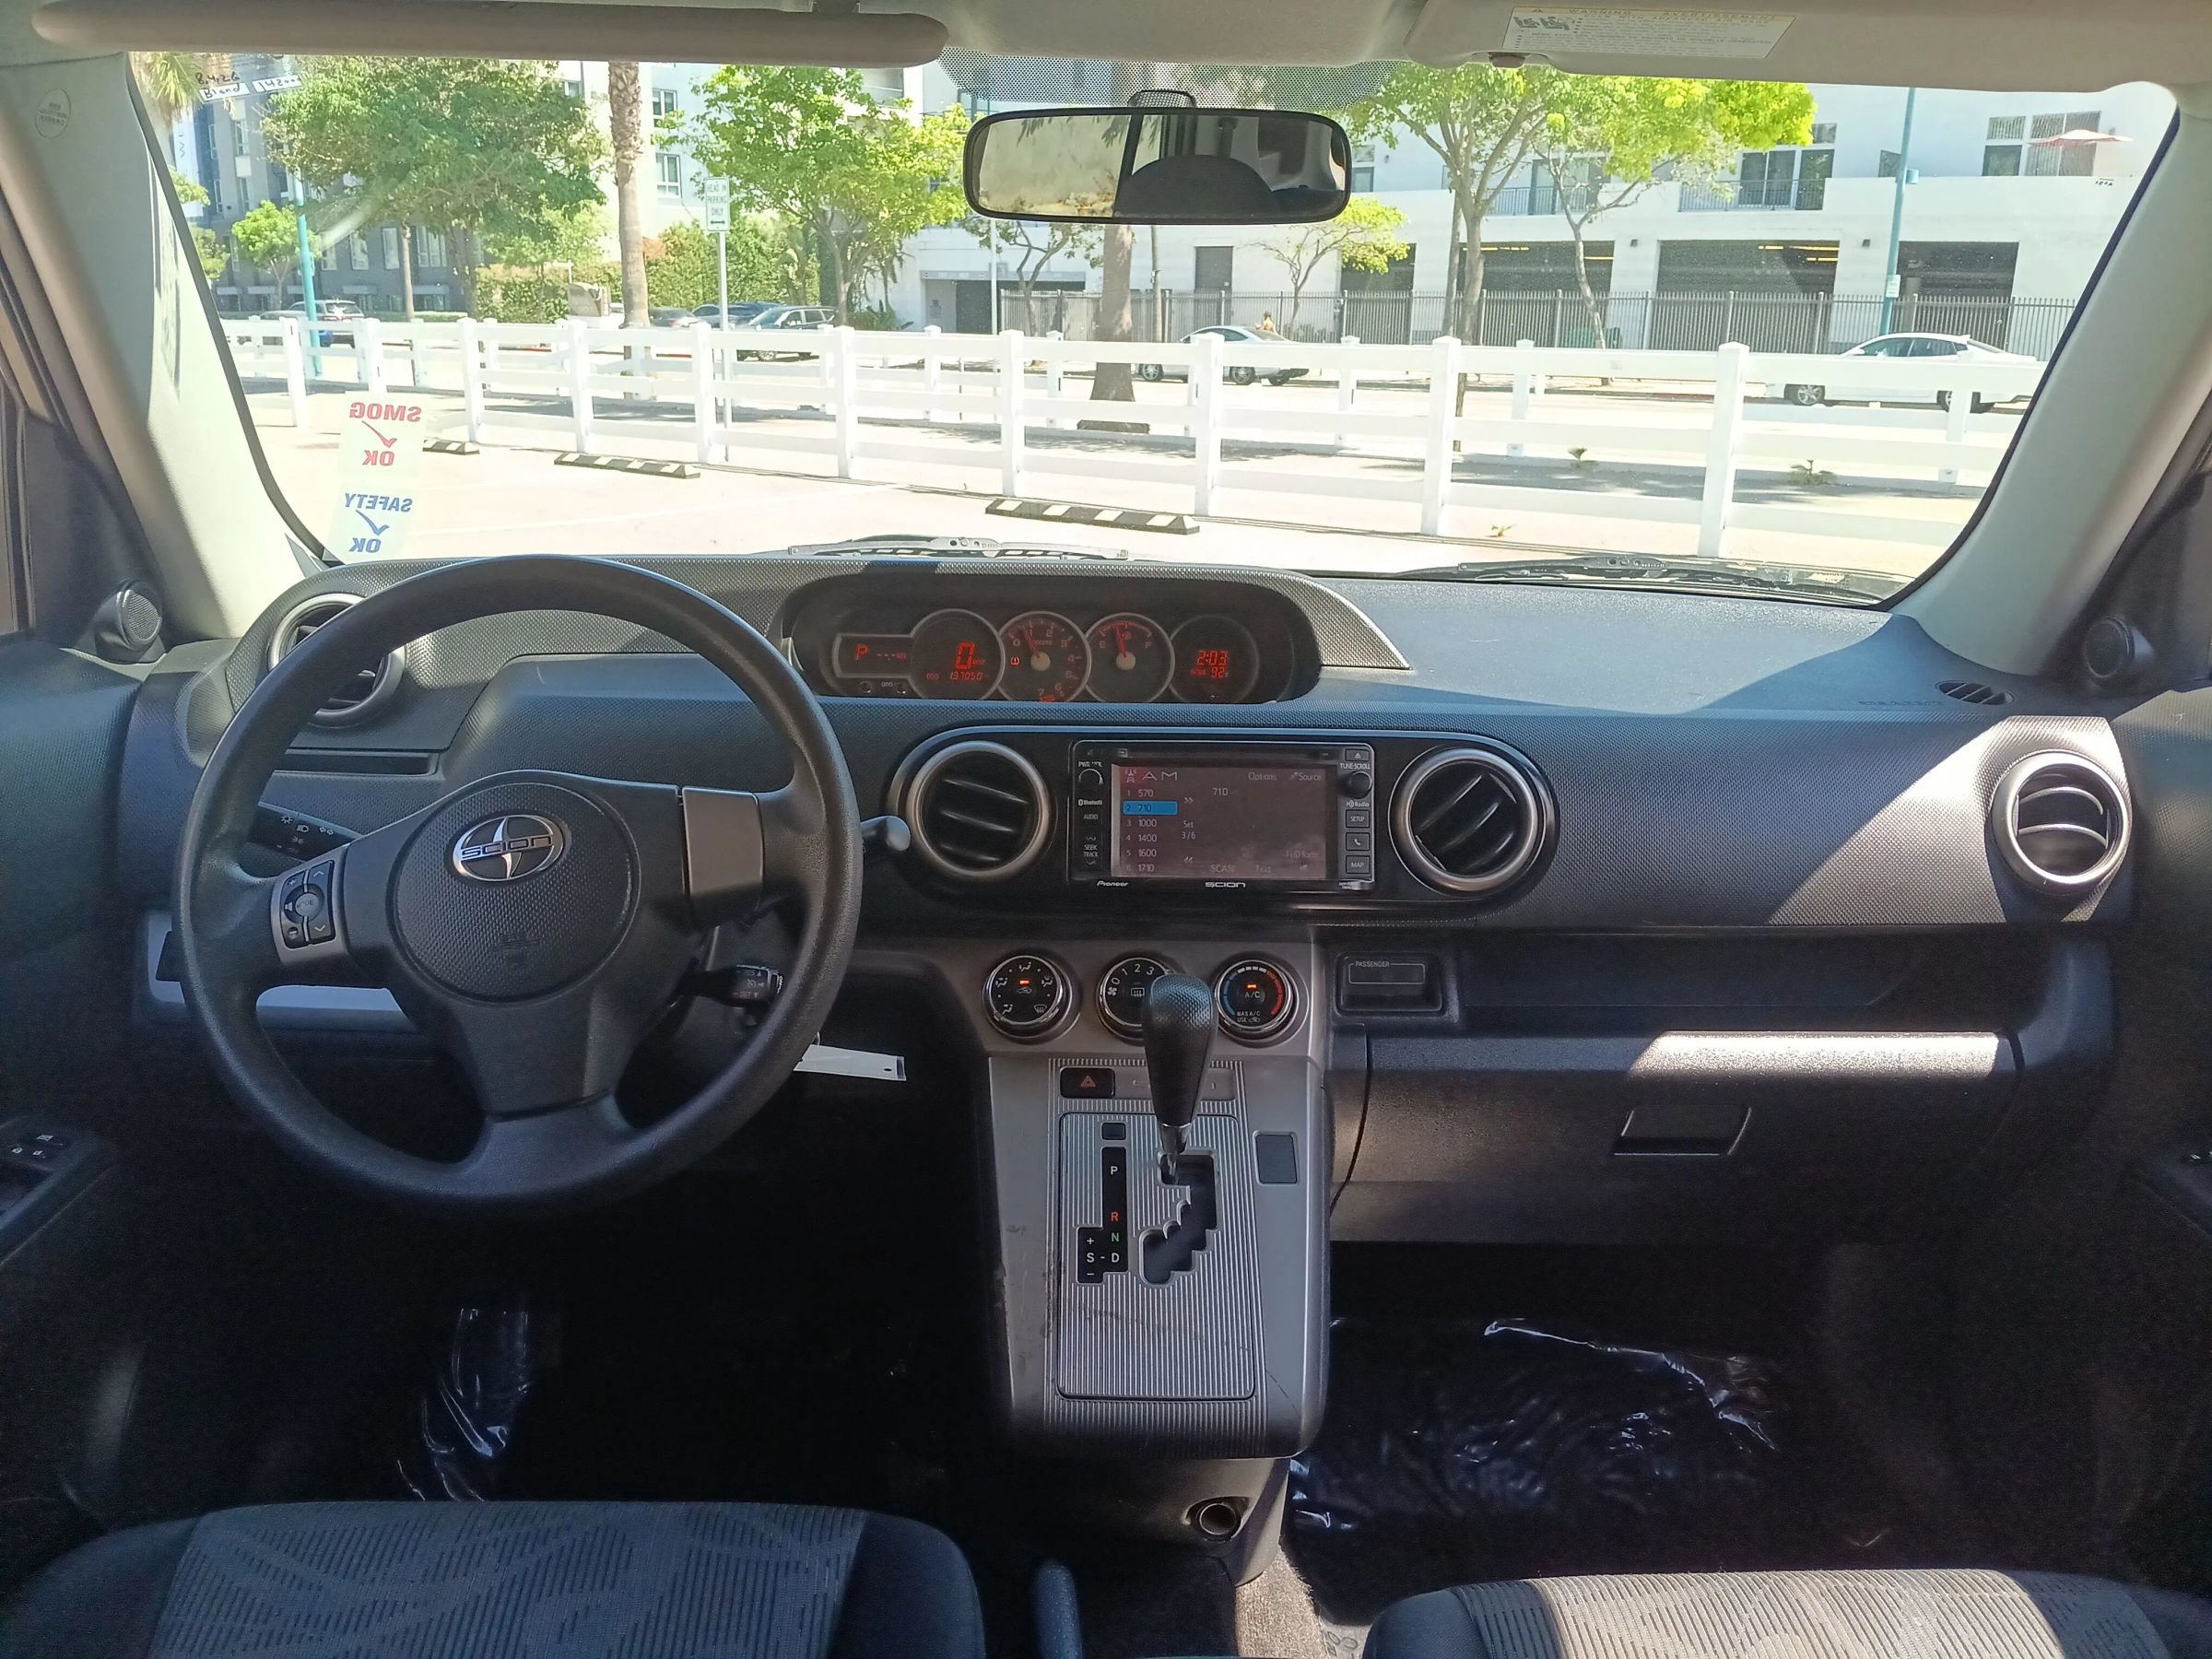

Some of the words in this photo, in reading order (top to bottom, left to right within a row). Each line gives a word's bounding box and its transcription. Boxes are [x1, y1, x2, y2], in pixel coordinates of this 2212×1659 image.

[855, 644, 869, 661] P
[955, 642, 975, 670] 0
[1196, 649, 1228, 665] 2:03
[949, 672, 983, 681] 137050
[1248, 771, 1277, 781] Options
[1298, 773, 1322, 782] Source
[1138, 789, 1154, 797] 570
[1212, 787, 1229, 796] 710
[1138, 804, 1152, 812] 710
[1138, 819, 1158, 828] 1000
[1182, 820, 1194, 829] Set
[1138, 833, 1158, 842] 1400
[1182, 831, 1196, 840] 3/6
[1138, 864, 1156, 873] 1710
[1122, 967, 1129, 976] 1
[1135, 964, 1141, 972] 2
[1146, 966, 1155, 976] 3
[1111, 977, 1121, 985] 0
[1110, 1165, 1119, 1176] P
[1111, 1212, 1119, 1222] R
[1111, 1232, 1120, 1242] N
[1086, 1252, 1095, 1264] S
[1111, 1253, 1120, 1264] D
